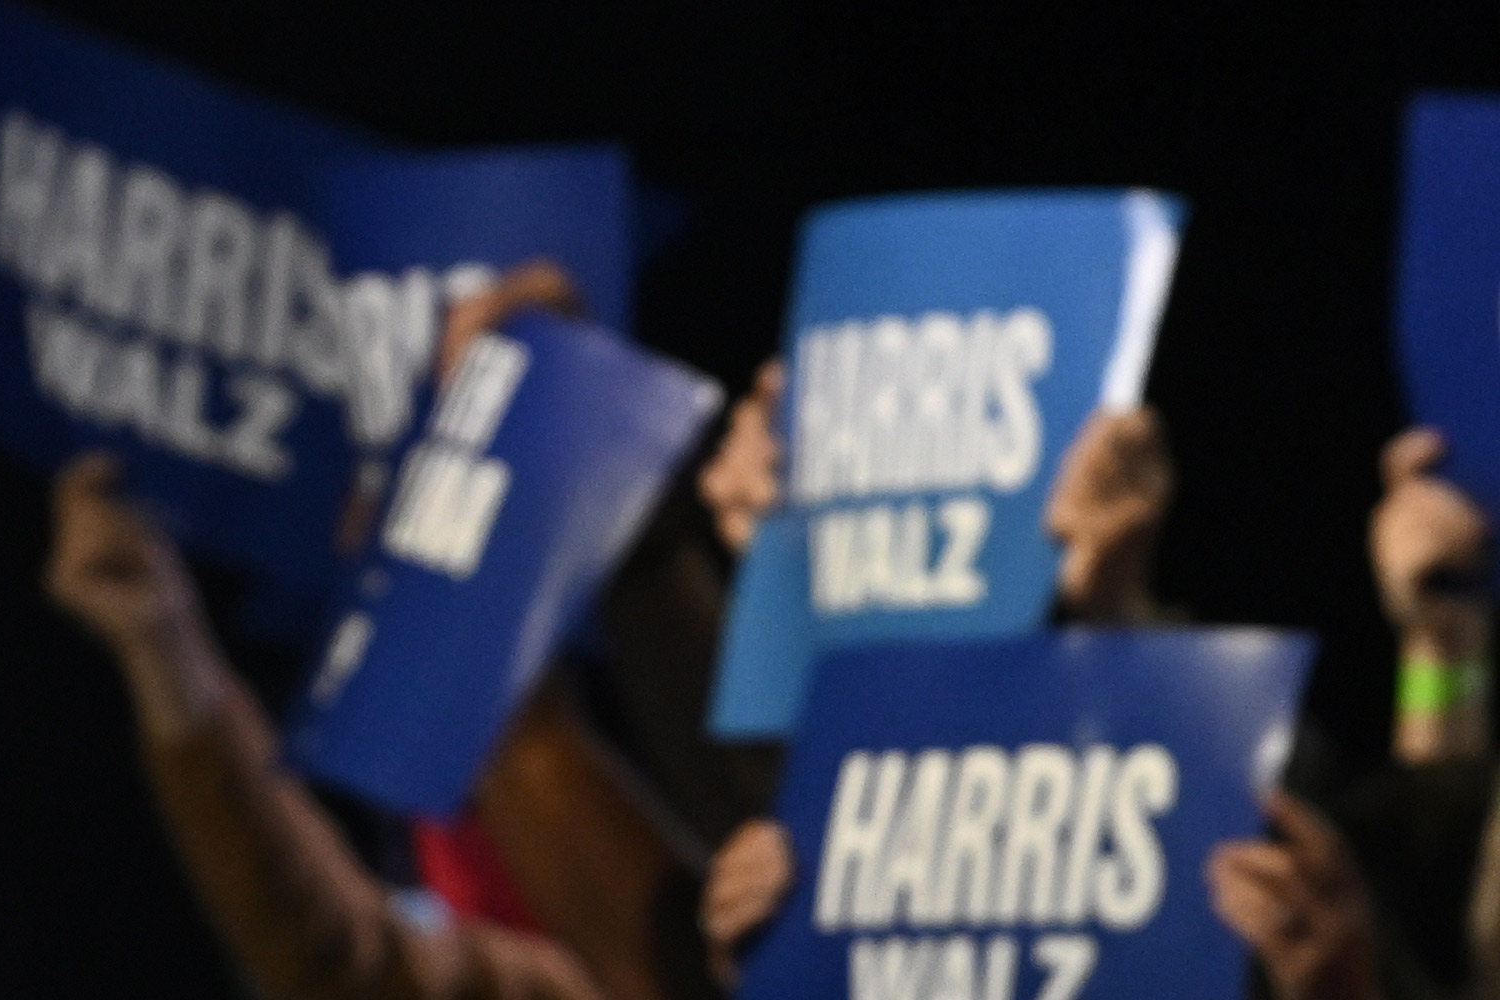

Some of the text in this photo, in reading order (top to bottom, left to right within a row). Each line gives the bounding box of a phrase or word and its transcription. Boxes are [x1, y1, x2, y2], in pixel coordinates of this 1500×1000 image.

[24, 302, 298, 484] WALZ
[793, 306, 1053, 504] HARRIS
[809, 498, 990, 617] WALZ
[813, 742, 1180, 933] HARRIS
